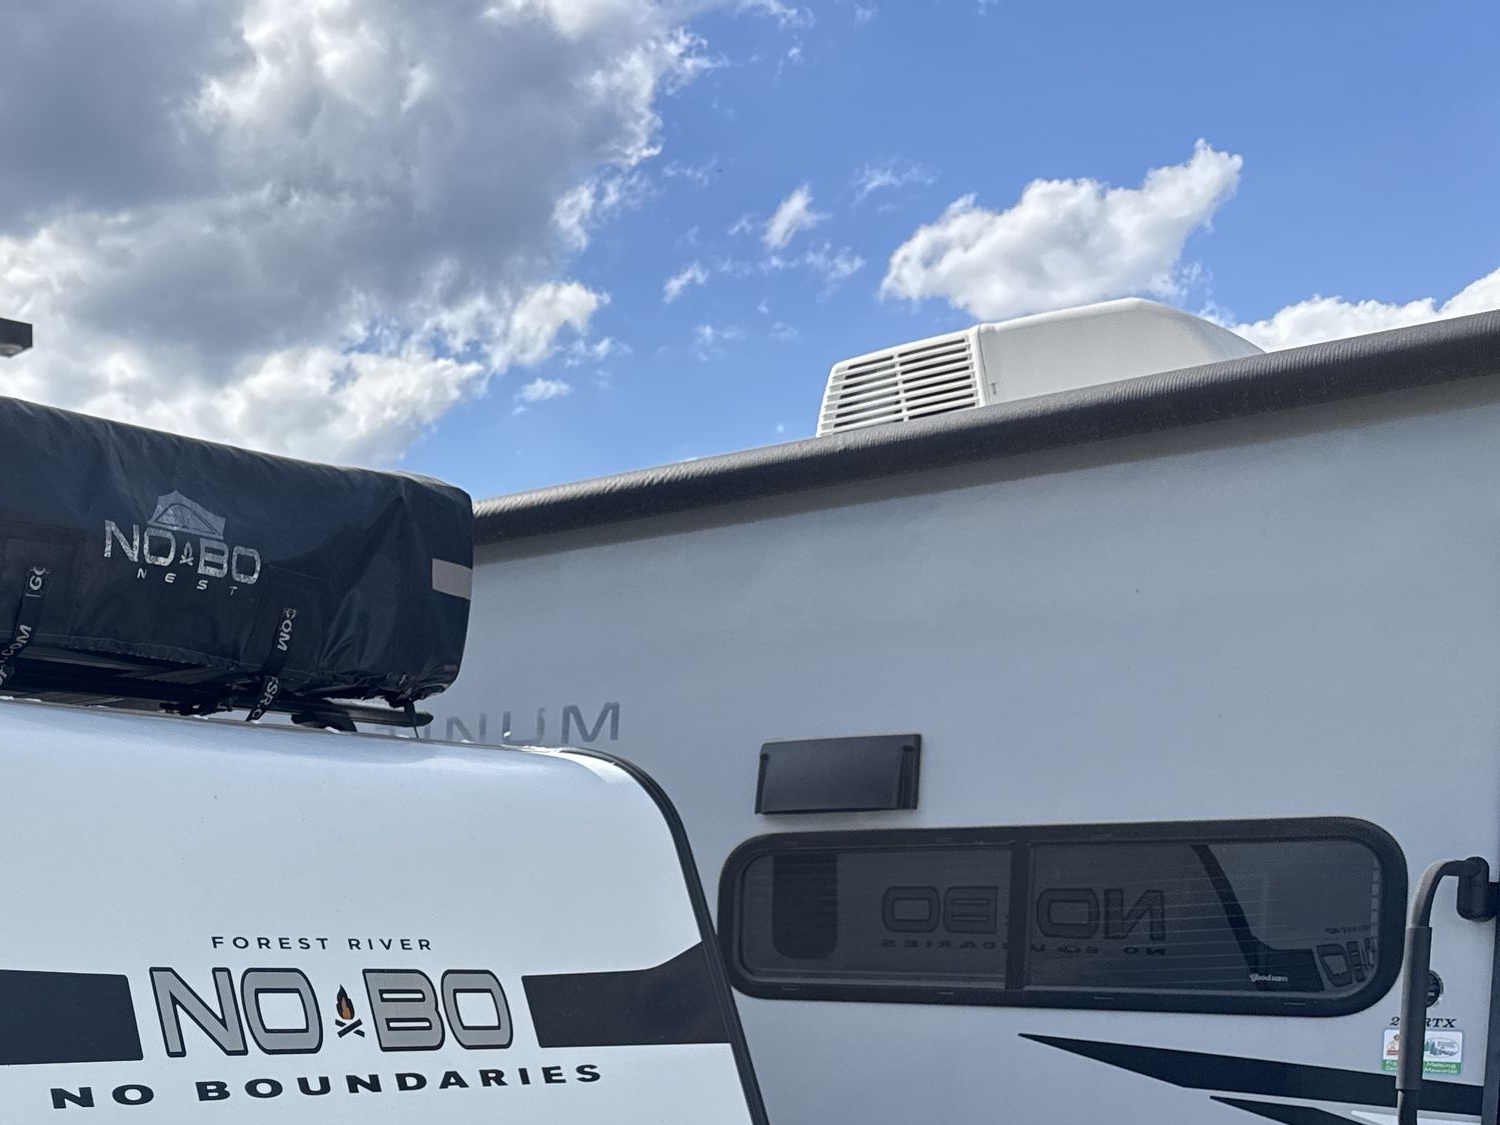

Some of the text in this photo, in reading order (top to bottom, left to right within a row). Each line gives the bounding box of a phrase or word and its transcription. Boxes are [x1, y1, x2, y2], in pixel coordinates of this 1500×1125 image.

[136, 567, 238, 596] NEST
[211, 935, 433, 951] FOREST RIVER
[50, 1064, 601, 1109] NO BOUNDARIES
